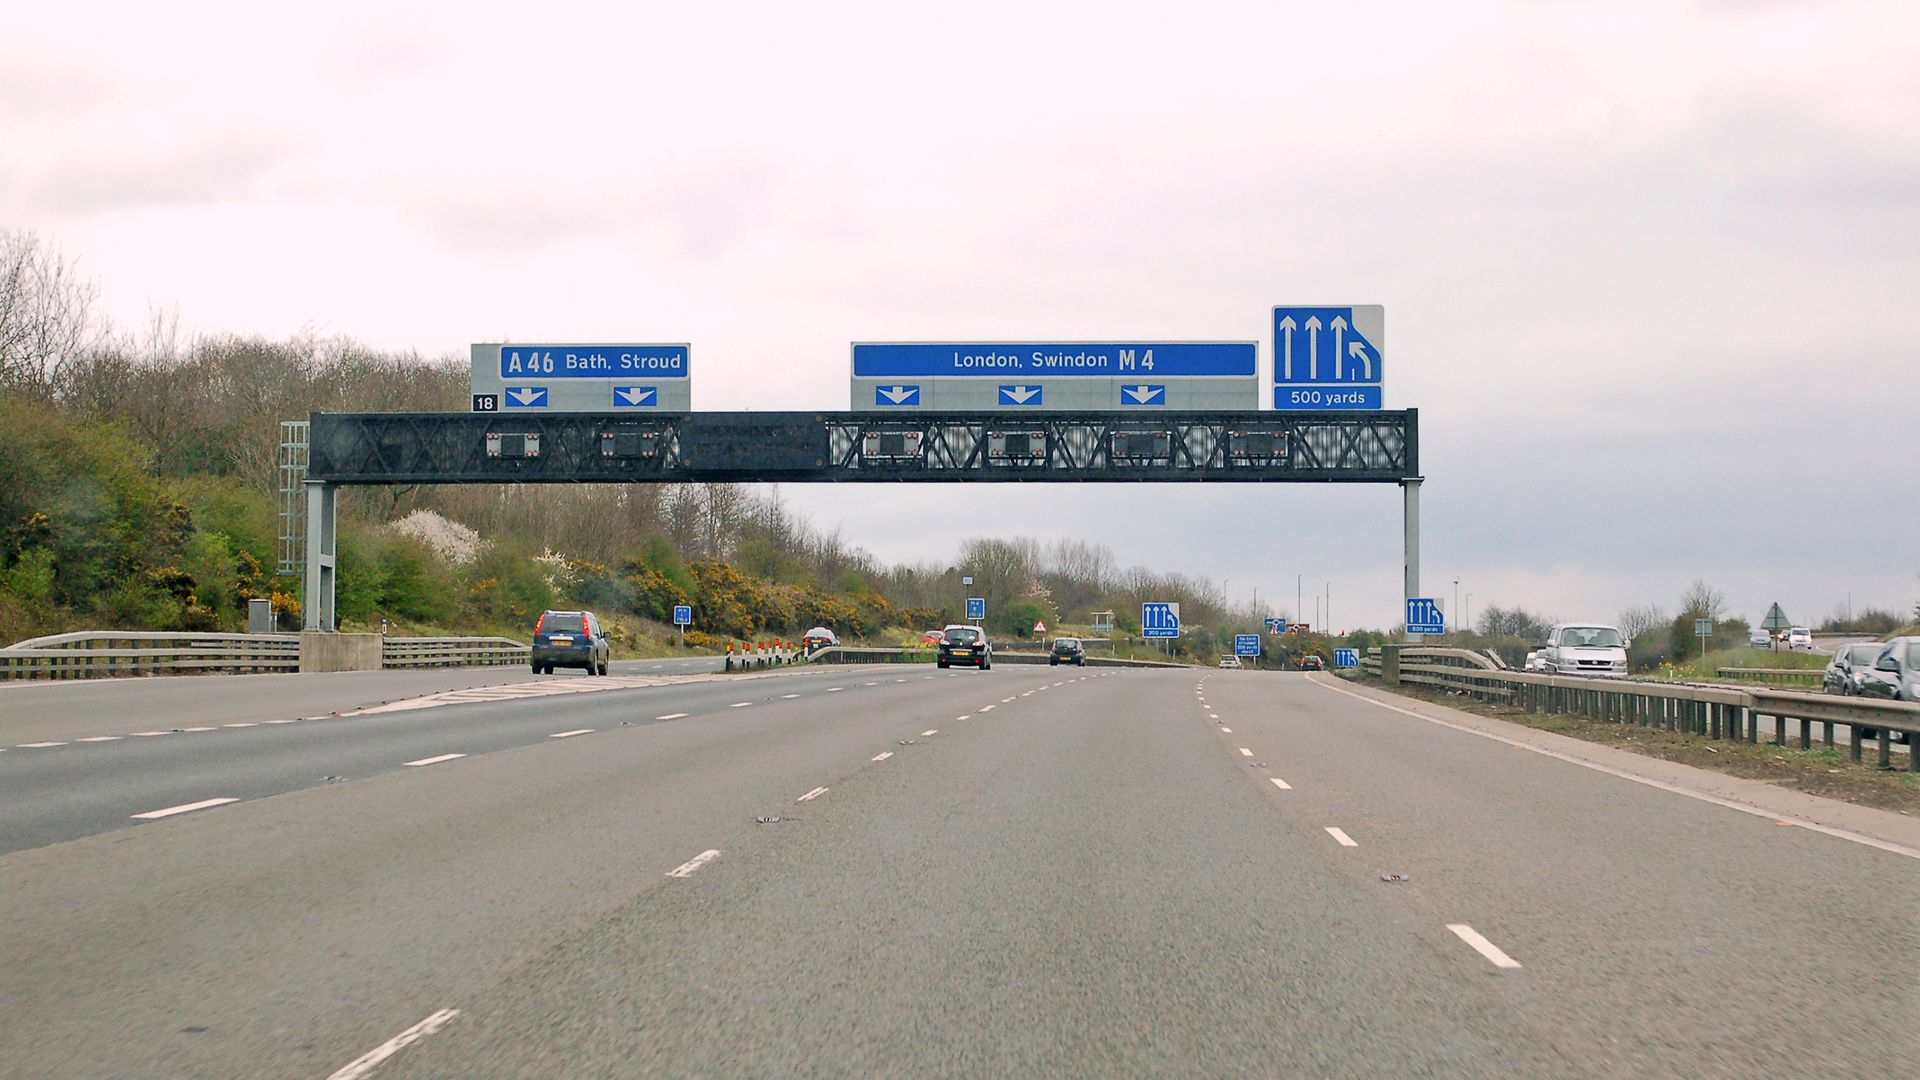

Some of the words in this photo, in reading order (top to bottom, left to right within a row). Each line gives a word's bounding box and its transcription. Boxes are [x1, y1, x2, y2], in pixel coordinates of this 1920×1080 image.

[509, 351, 554, 373] A46
[566, 353, 612, 371] Bath,
[620, 353, 681, 369] Stroud
[954, 352, 1024, 369] London,
[1032, 352, 1108, 368] Swindon
[1119, 349, 1155, 371] M4
[477, 397, 493, 410] 18
[1291, 390, 1321, 404] 500
[1325, 391, 1365, 406] yards
